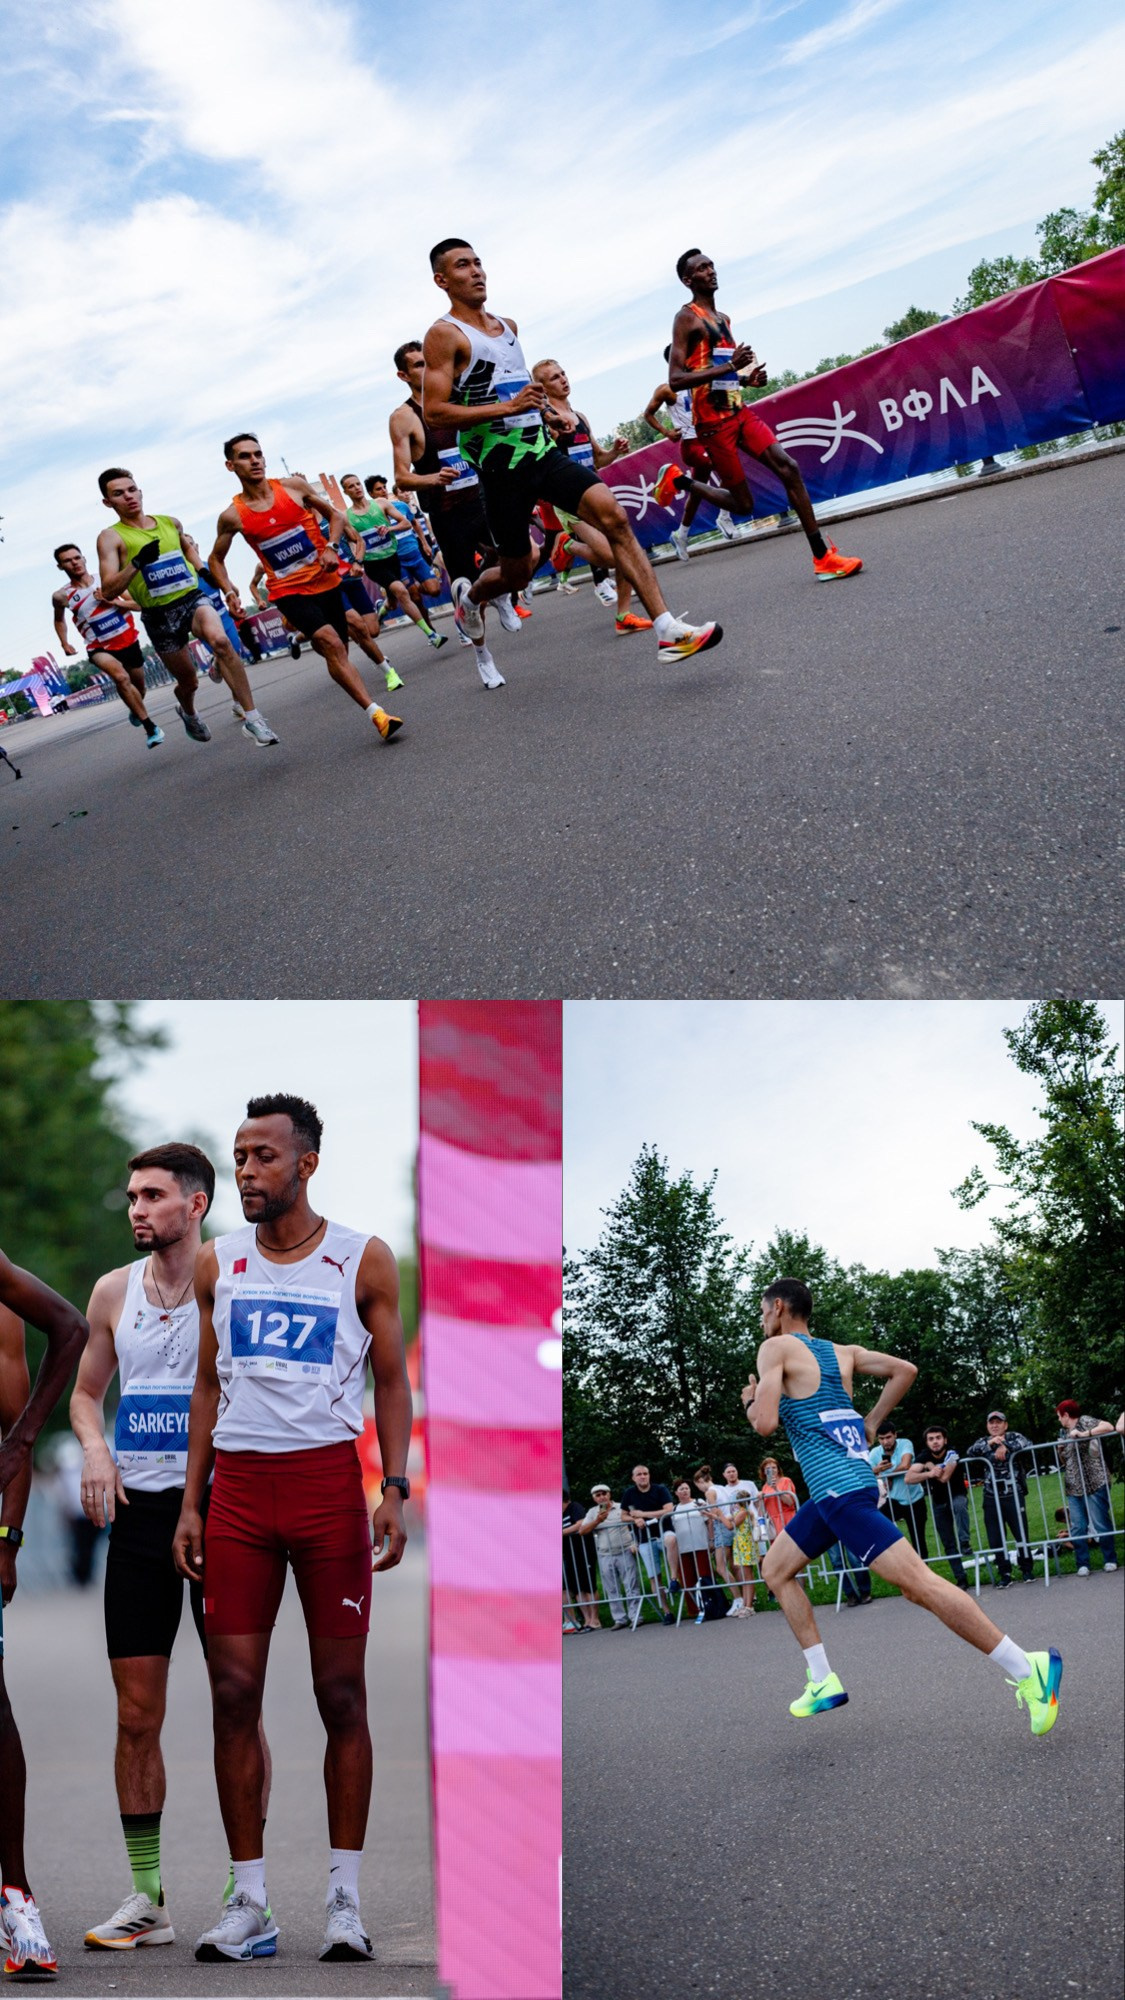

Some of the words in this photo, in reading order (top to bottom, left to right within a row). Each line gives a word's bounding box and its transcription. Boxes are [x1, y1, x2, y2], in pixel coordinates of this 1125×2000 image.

[878, 365, 1002, 432] ВФЛА
[275, 542, 304, 561] VOLKOV
[247, 1310, 318, 1350] 127
[833, 1425, 862, 1447] 139
